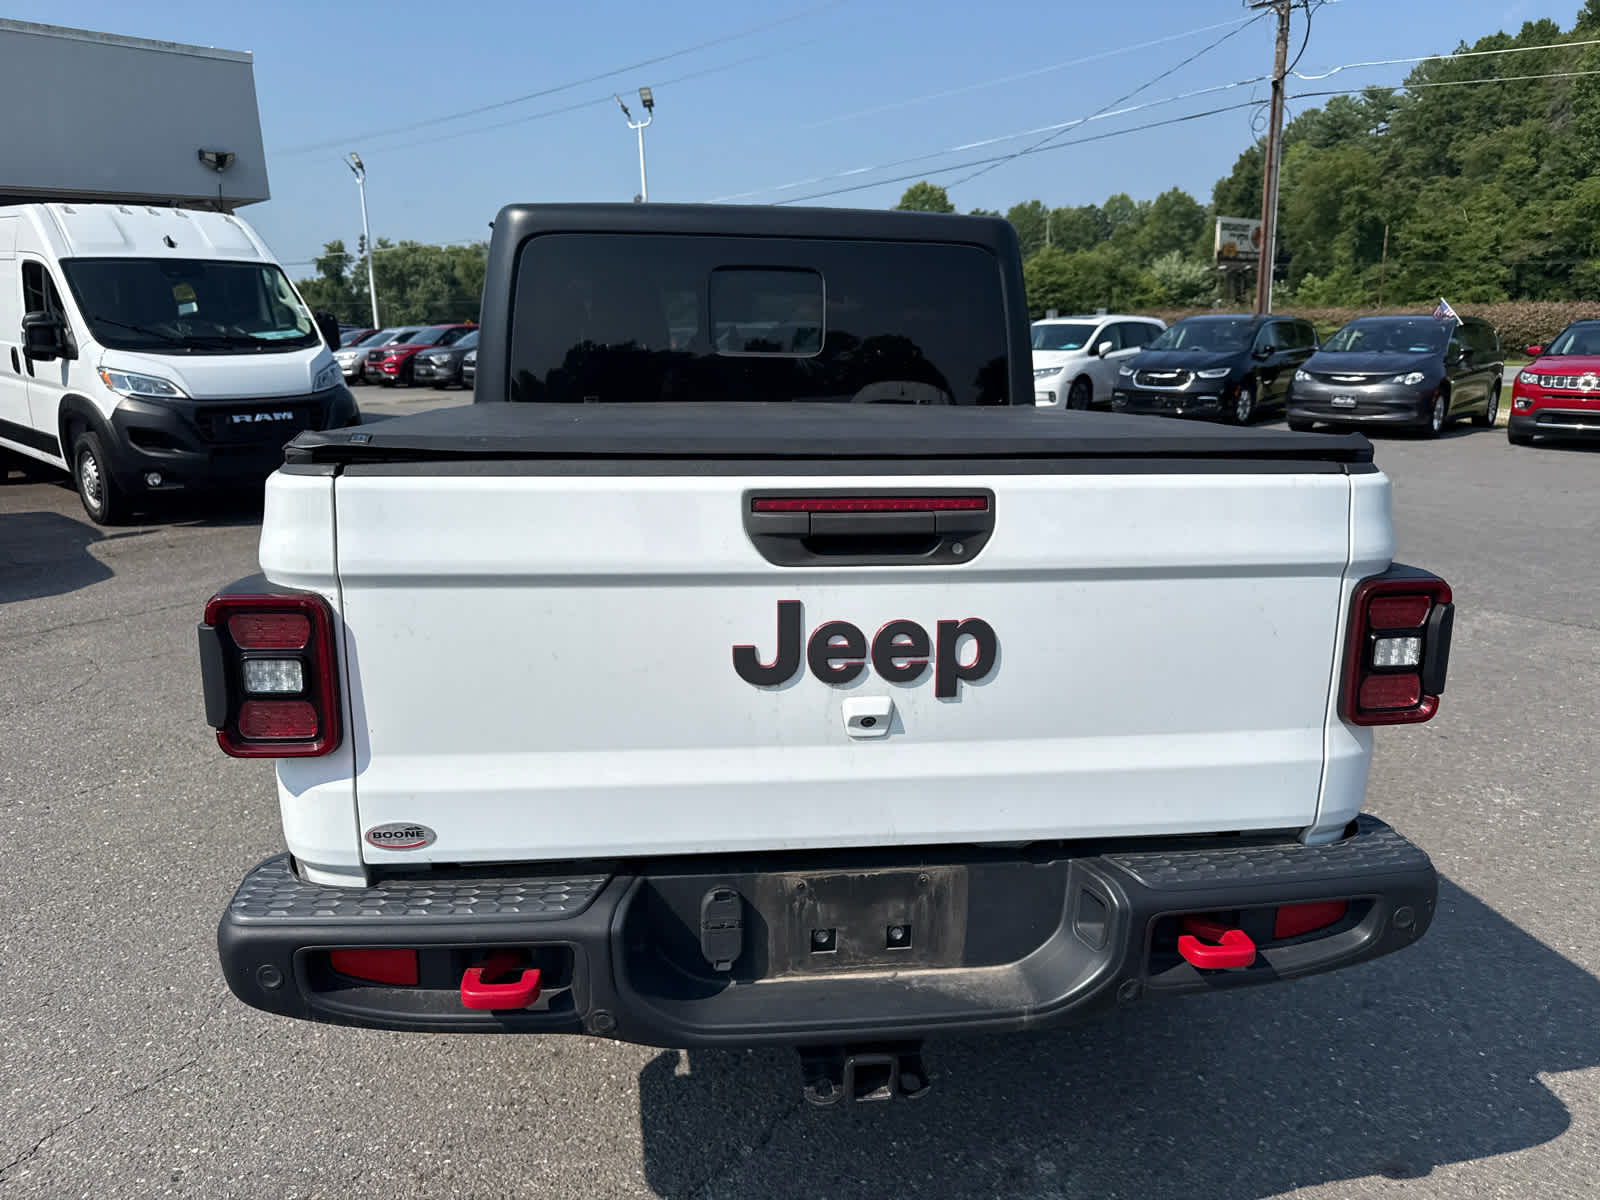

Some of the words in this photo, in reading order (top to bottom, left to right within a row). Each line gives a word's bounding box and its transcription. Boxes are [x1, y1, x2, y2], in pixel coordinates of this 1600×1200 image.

[232, 411, 293, 423] RAM
[732, 600, 997, 697] Jeep
[372, 831, 425, 839] BOONE
